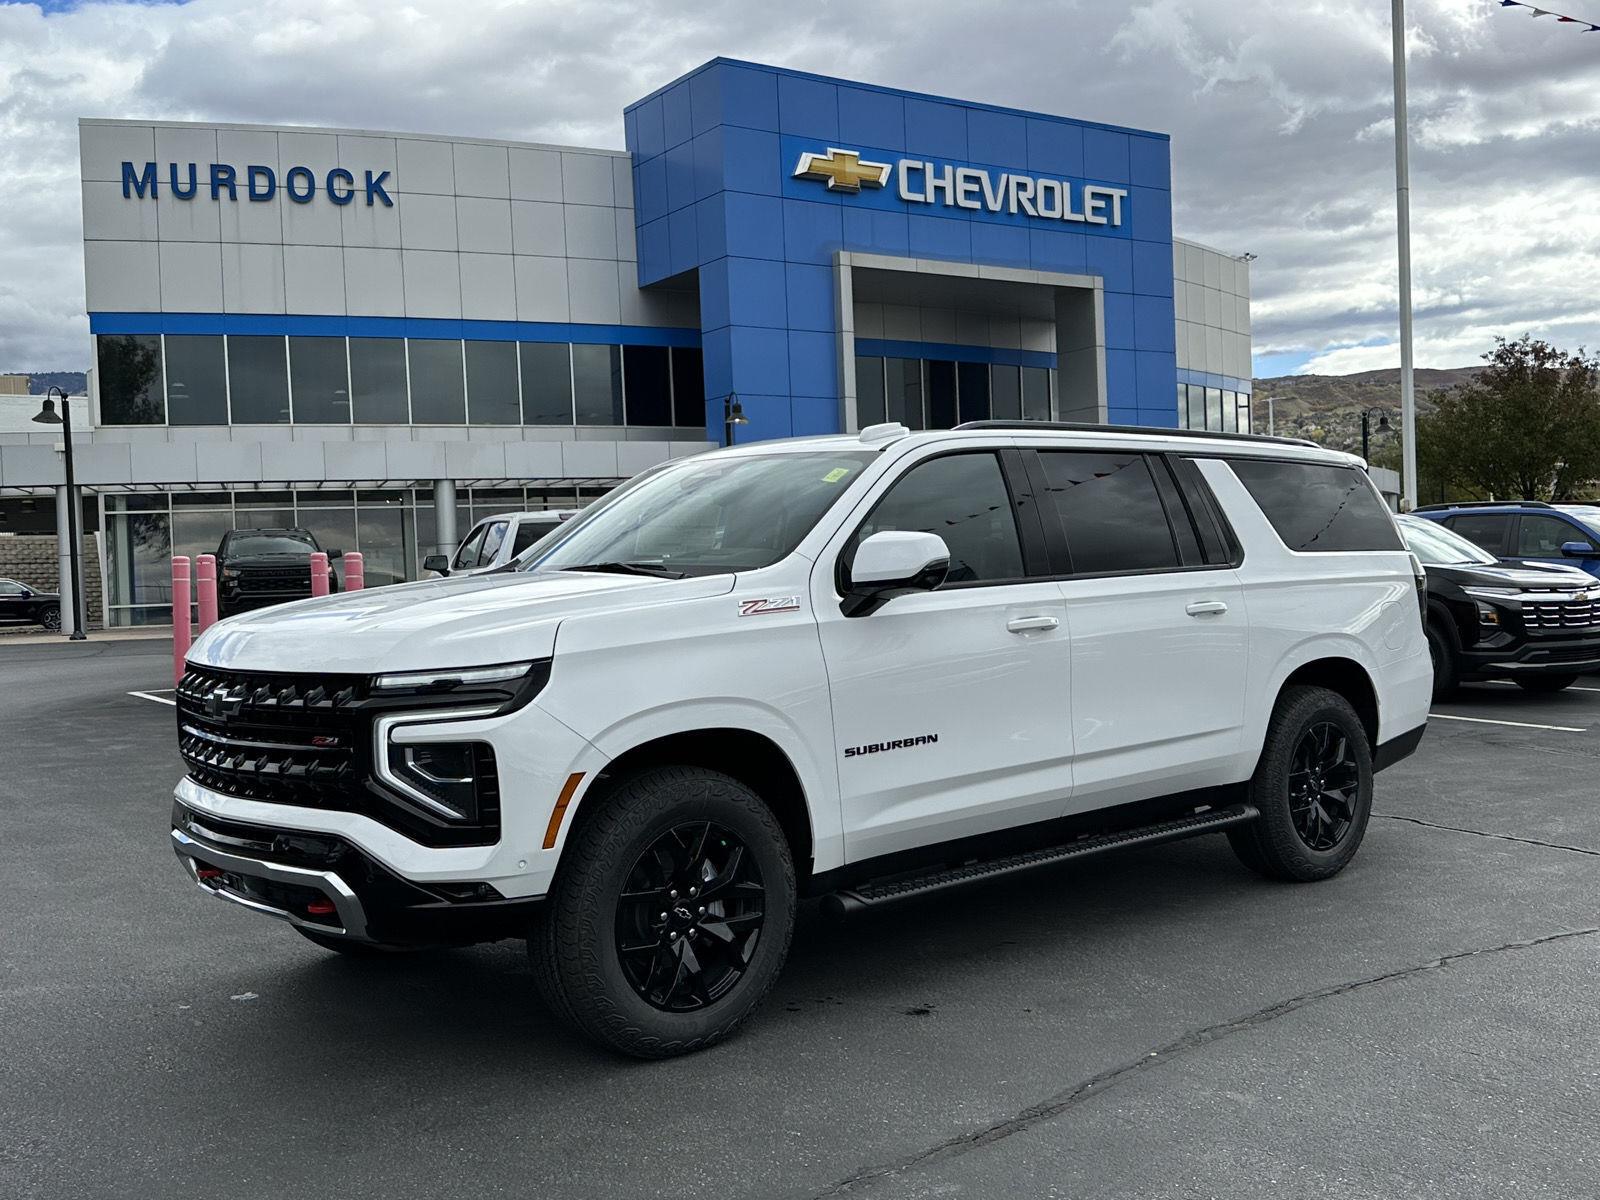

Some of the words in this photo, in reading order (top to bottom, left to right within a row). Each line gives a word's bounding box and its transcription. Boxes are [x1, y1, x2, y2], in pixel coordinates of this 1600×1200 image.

[121, 161, 394, 207] MURDOCK
[898, 159, 1128, 226] CHEVROLET
[738, 596, 801, 617] Z71
[844, 733, 938, 758] SUBURBAN
